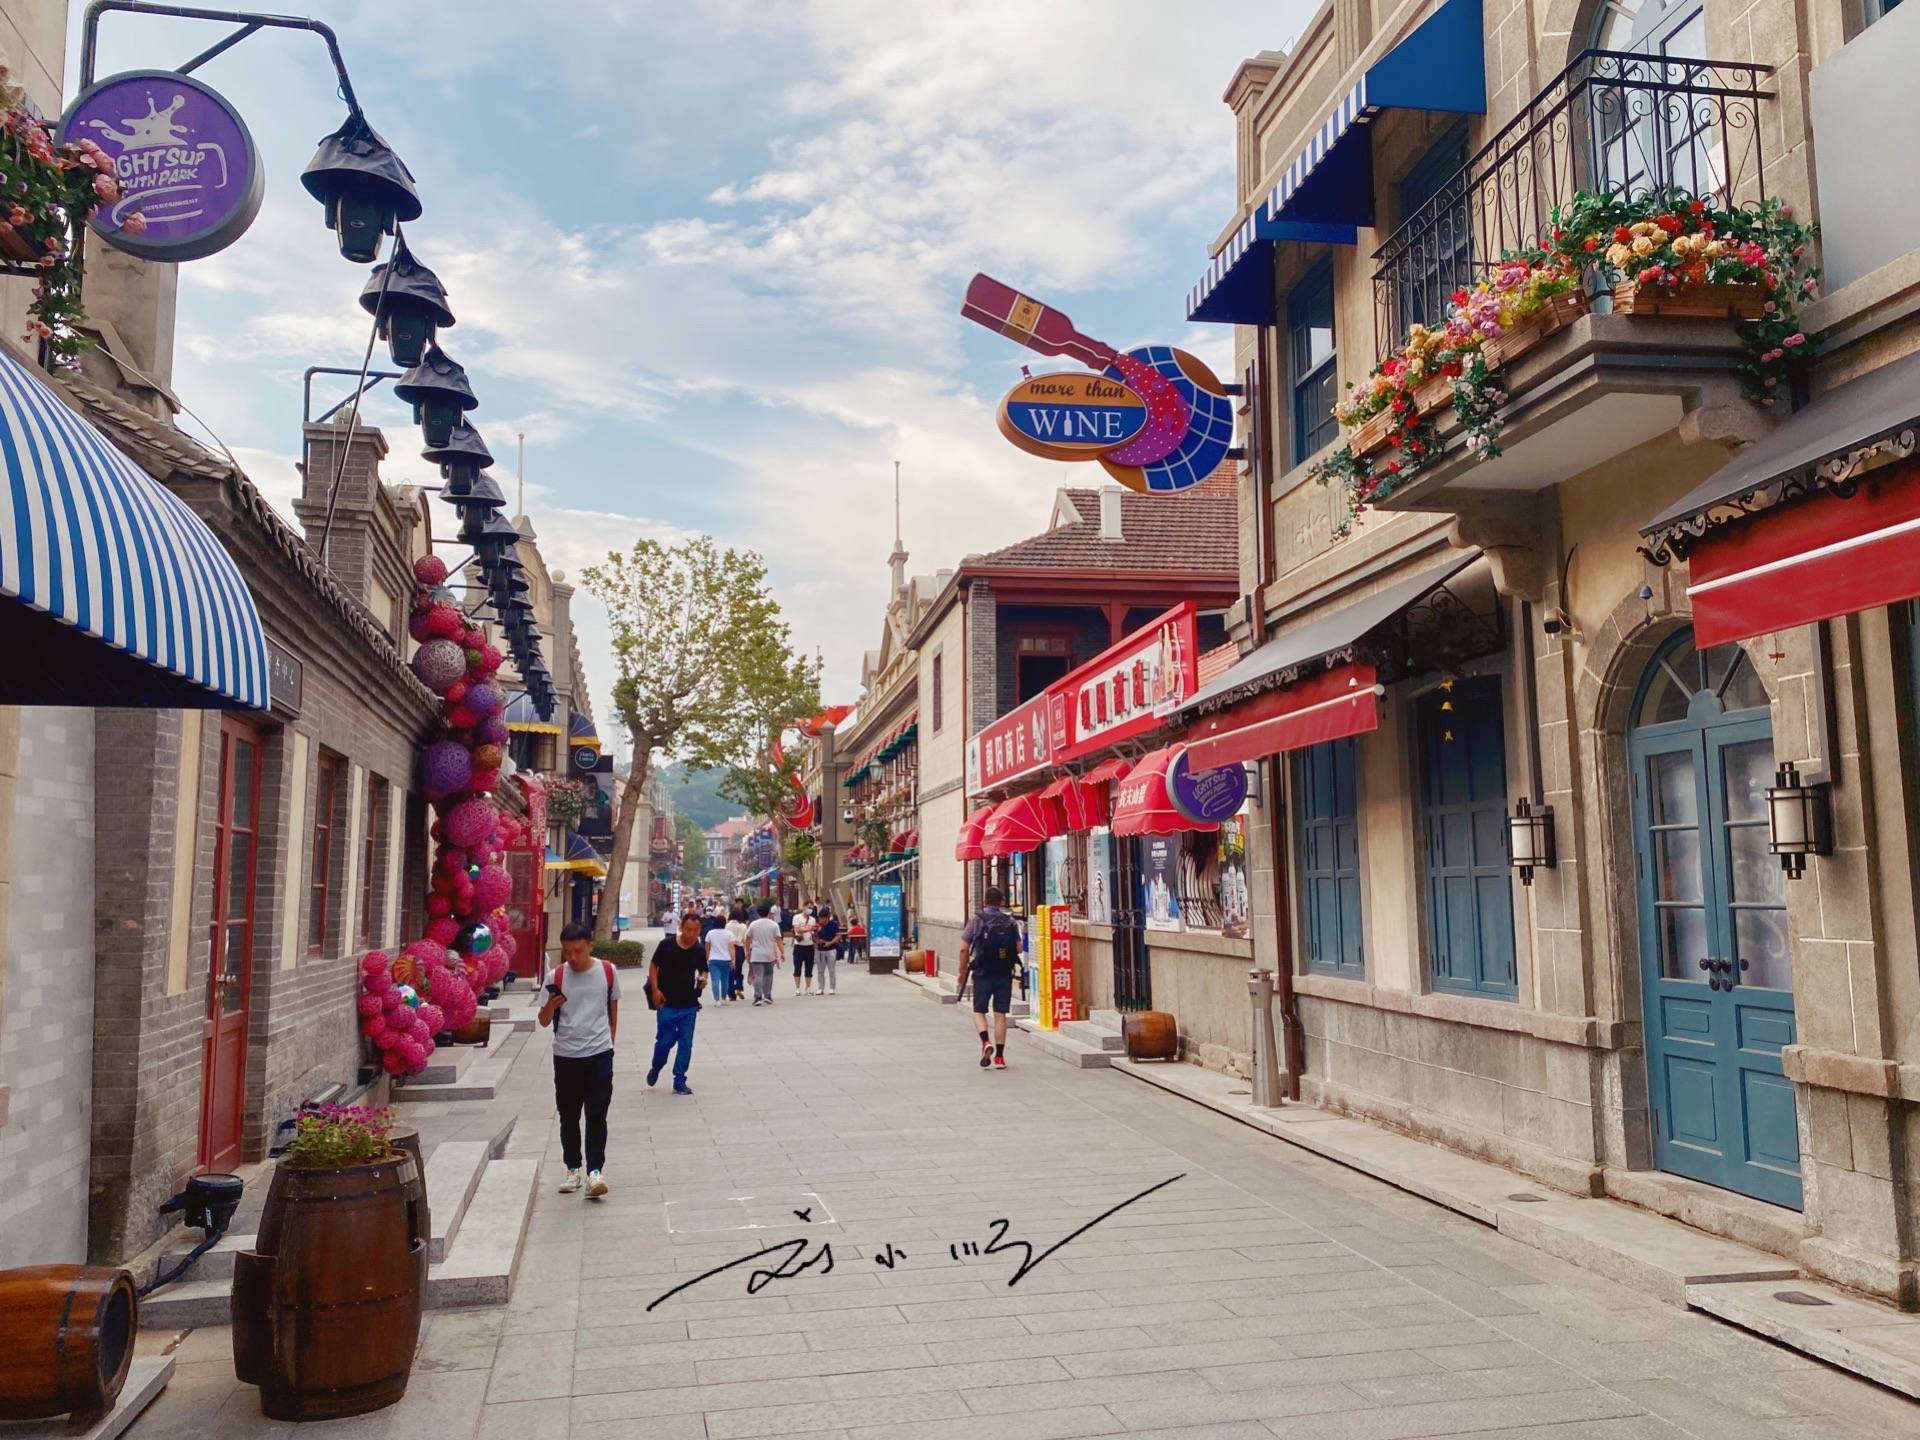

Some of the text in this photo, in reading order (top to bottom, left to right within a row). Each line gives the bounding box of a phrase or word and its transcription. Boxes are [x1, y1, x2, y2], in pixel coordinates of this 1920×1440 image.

[158, 168, 199, 187] PARK
[1029, 379, 1126, 399] more than
[1027, 407, 1125, 440] WINE
[1051, 910, 1073, 1021] 朝阳商店
